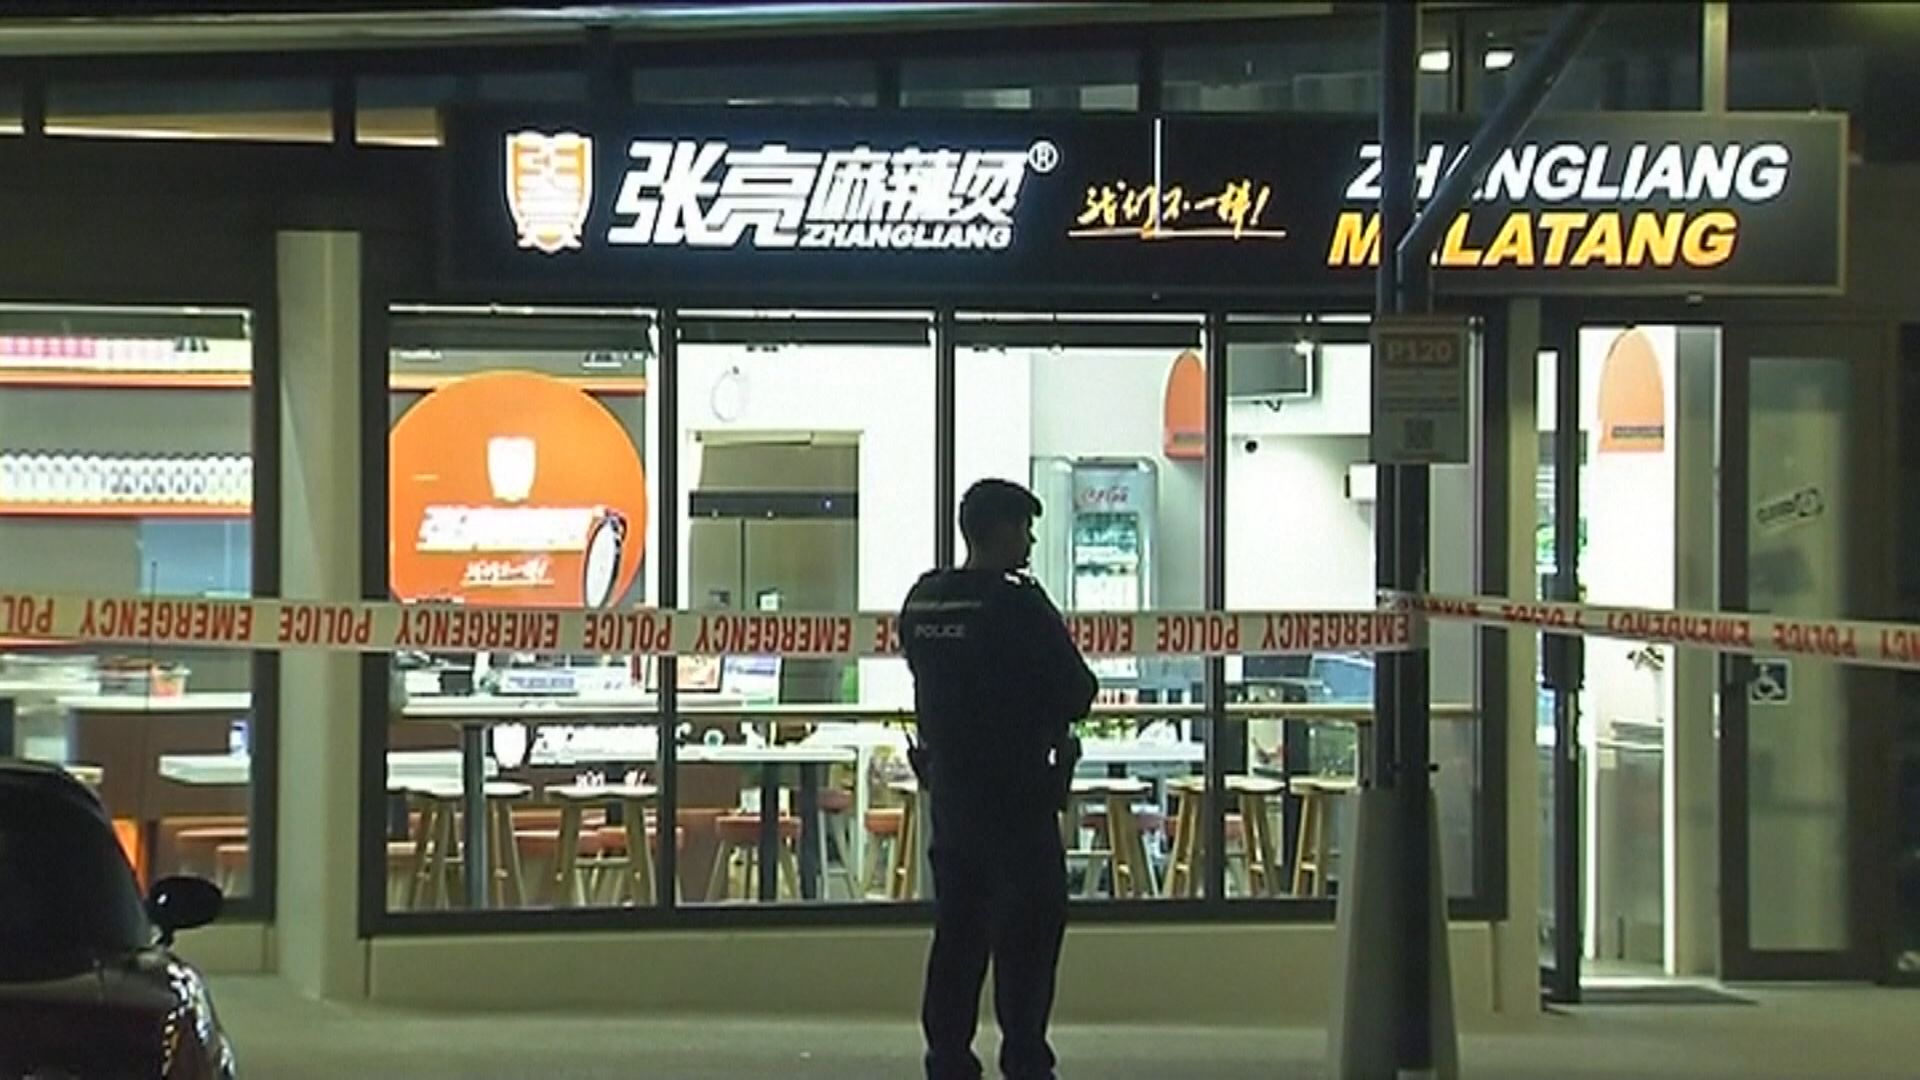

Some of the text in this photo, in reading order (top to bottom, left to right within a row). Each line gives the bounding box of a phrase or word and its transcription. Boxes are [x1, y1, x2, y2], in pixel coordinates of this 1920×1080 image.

[1346, 144, 1790, 200] ZHNGLIANG
[608, 141, 1028, 247] 张亮麻辣烫
[800, 224, 1012, 249] ZHANGLIANG
[1327, 211, 1737, 267] MLATANG
[1387, 339, 1454, 362] P120
[79, 599, 254, 640] EMERGENCY
[278, 605, 373, 645] POLICE
[395, 608, 560, 649] EMERGENCY
[583, 612, 673, 651] POLICE
[695, 614, 851, 653] EMERGENCY
[913, 623, 966, 639] POLICE
[1157, 614, 1240, 652] POLICE
[1262, 612, 1409, 650] EMERGENCY
[1771, 621, 1858, 659] POLICE
